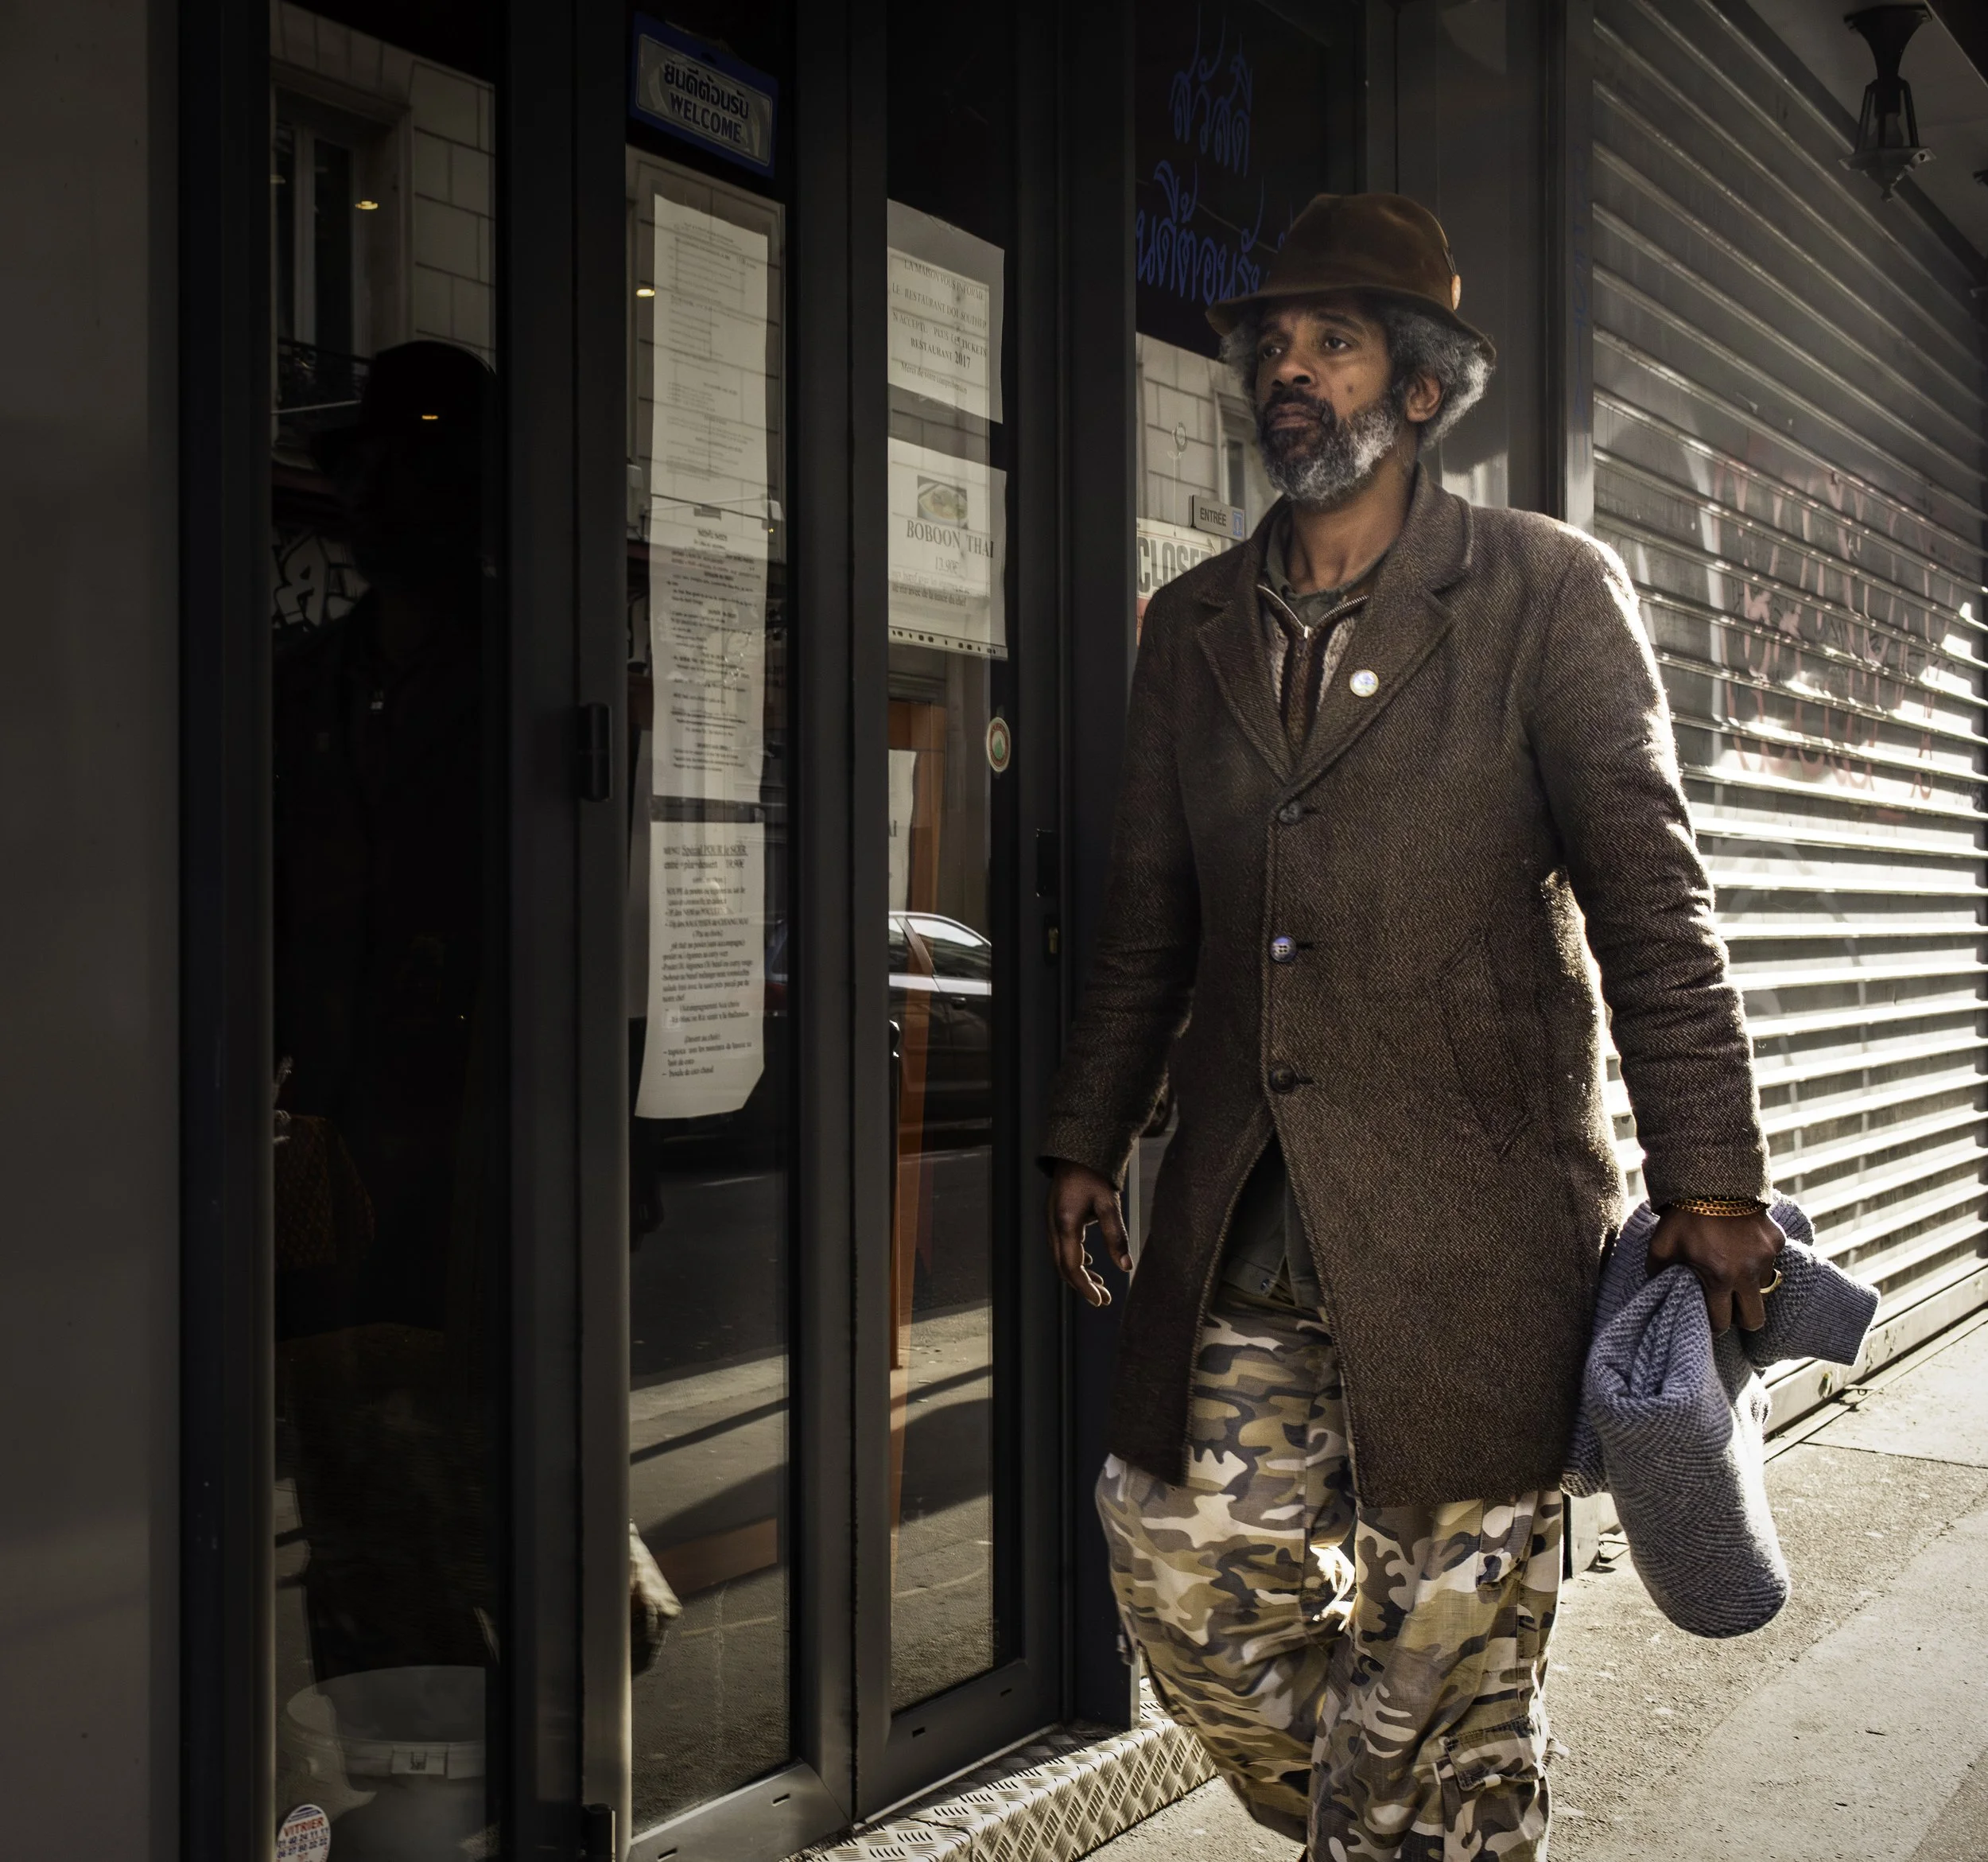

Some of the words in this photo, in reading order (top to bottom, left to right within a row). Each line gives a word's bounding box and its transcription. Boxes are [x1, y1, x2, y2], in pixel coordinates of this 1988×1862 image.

[670, 91, 742, 143] WELCOME
[914, 261, 939, 281] MAISON
[904, 287, 945, 311] RESTAURANT
[910, 336, 953, 361] RESTAURANT
[953, 351, 971, 368] 2017
[961, 337, 988, 358] TICKETS
[1200, 507, 1226, 527] ENTRÉE
[907, 519, 960, 549] BOBOON
[965, 534, 994, 558] THAI
[284, 1817, 324, 1837] VITRIER
